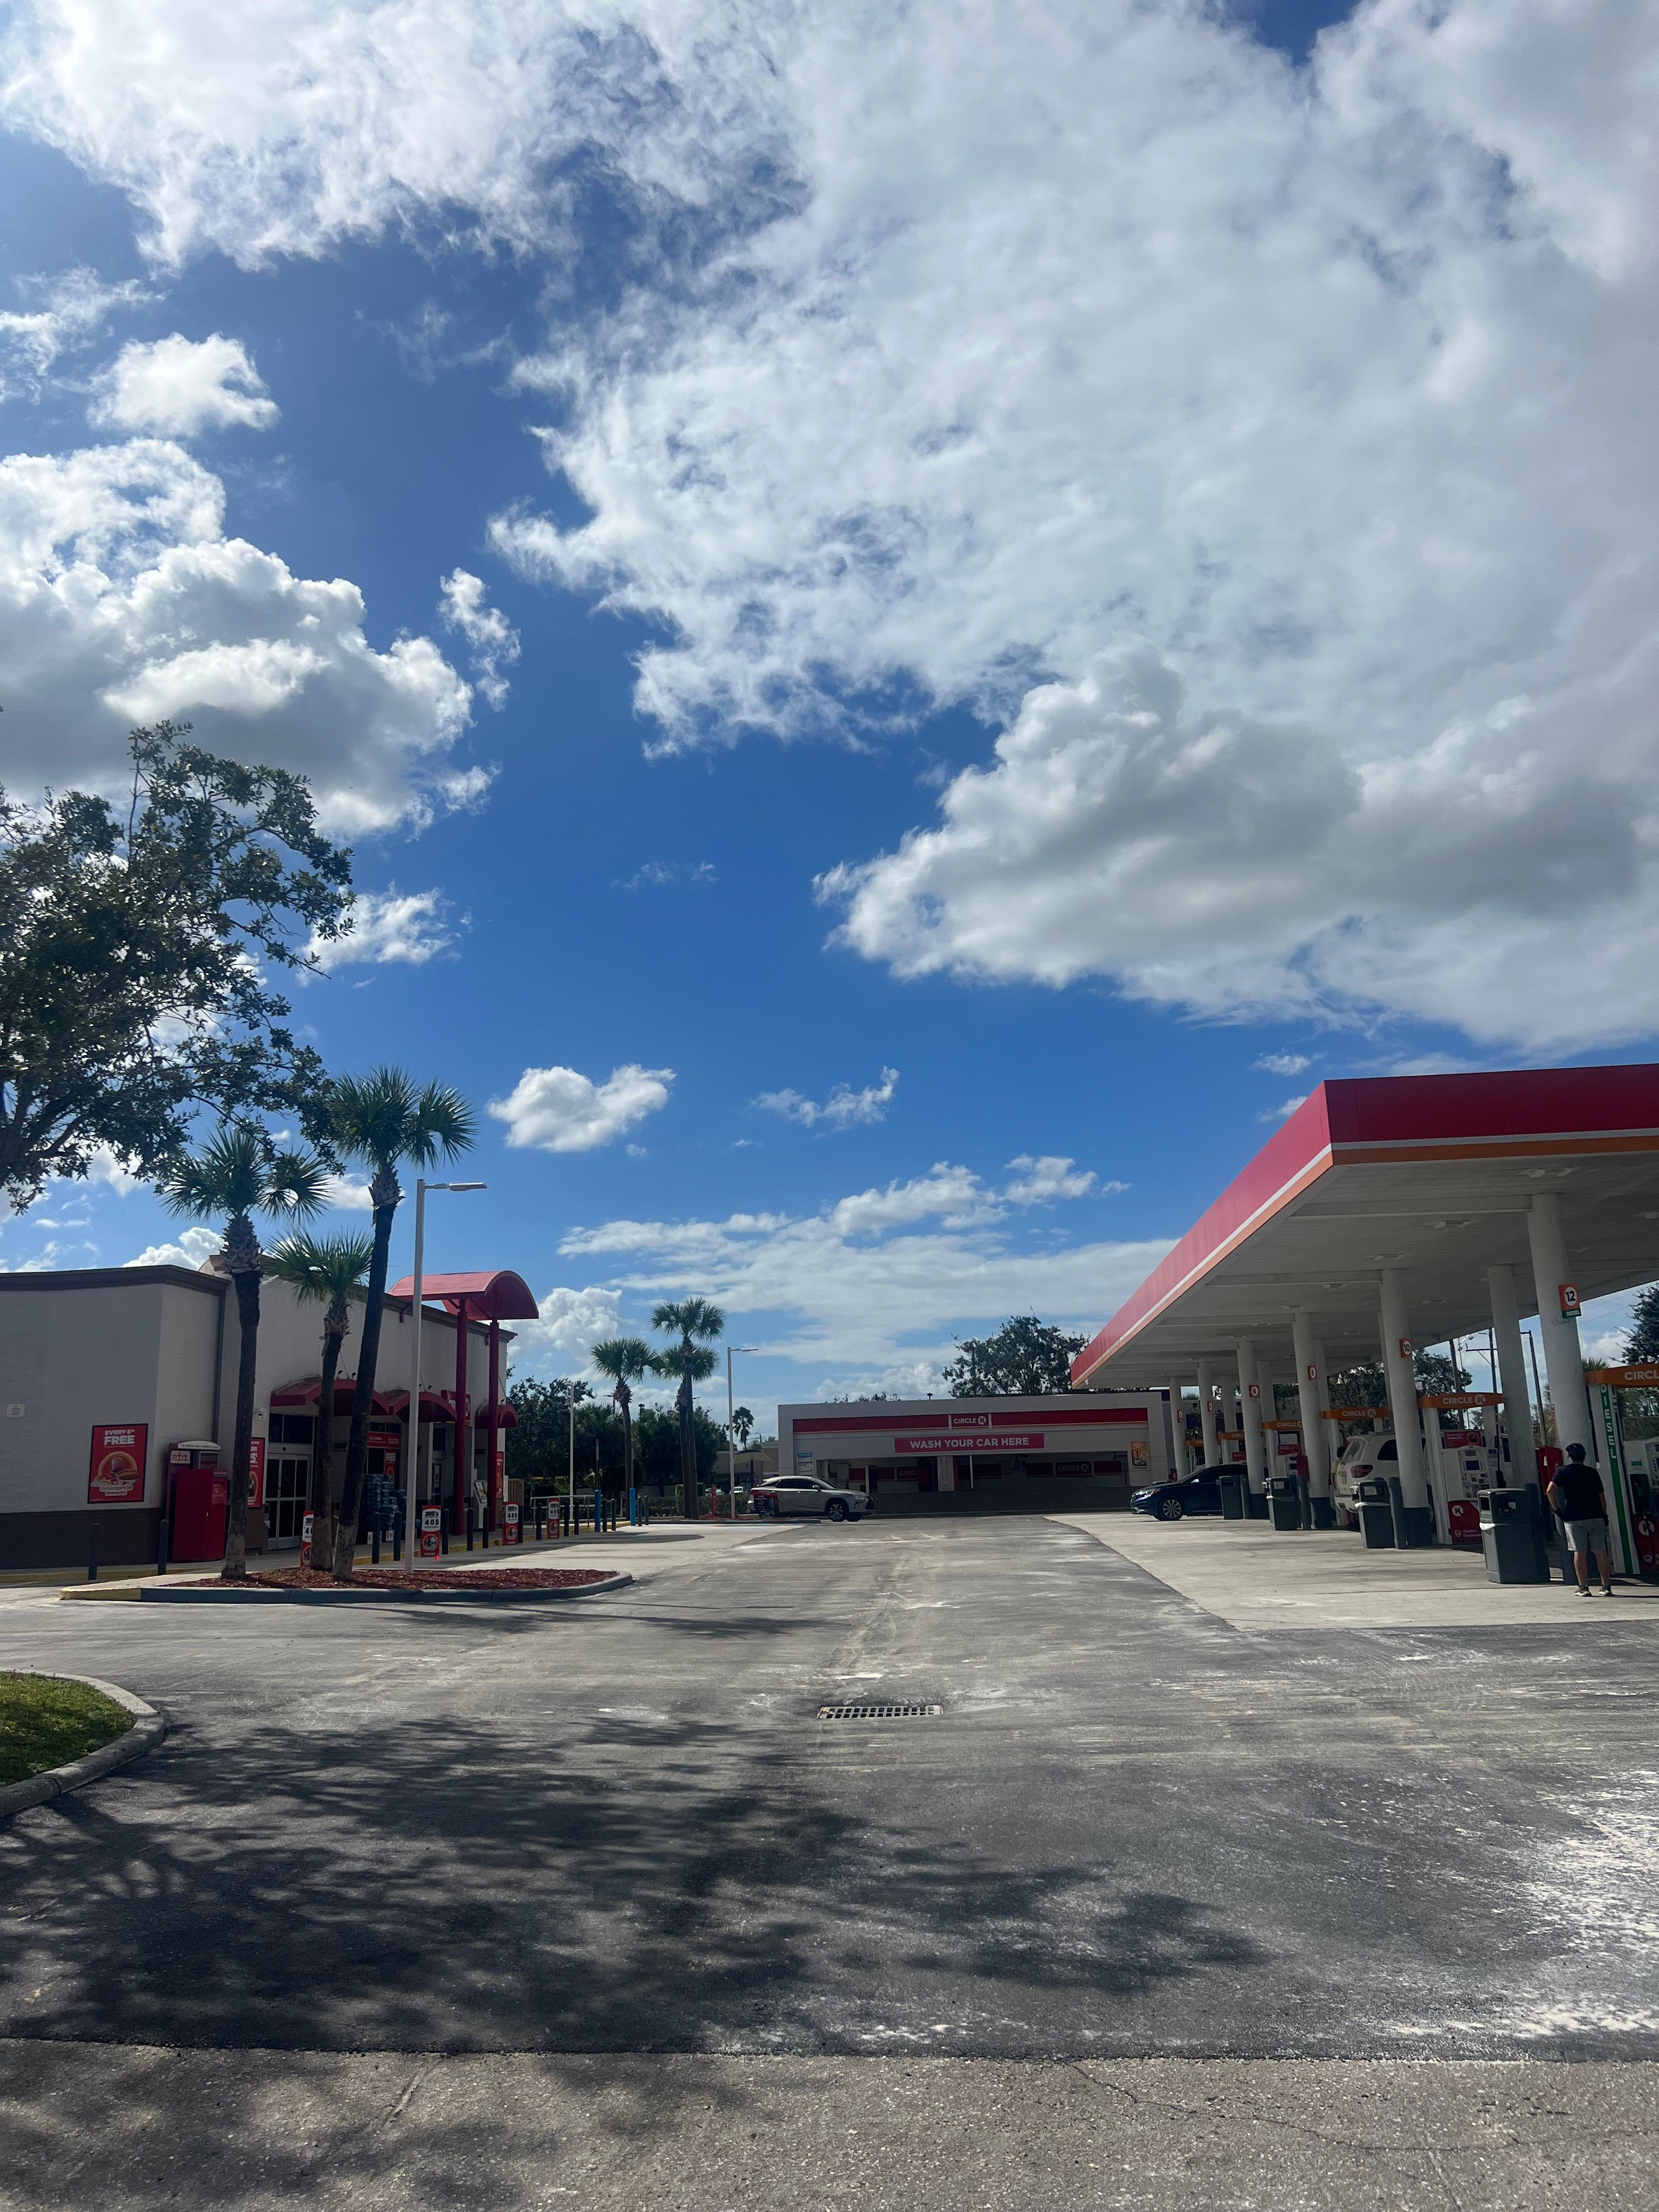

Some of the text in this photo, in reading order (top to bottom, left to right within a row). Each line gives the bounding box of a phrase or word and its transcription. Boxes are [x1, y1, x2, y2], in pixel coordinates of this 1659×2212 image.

[1566, 1290, 1576, 1302] 12
[1403, 1344, 1410, 1352] 10
[1624, 1370, 1659, 1381] CIRCL
[1475, 1395, 1486, 1404] K
[978, 1417, 986, 1425] K
[1600, 1384, 1617, 1459] DIESEL
[104, 1435, 135, 1446] FREE
[910, 1437, 1029, 1449] WASH YOUR CAR HERE
[1453, 1506, 1463, 1516] K
